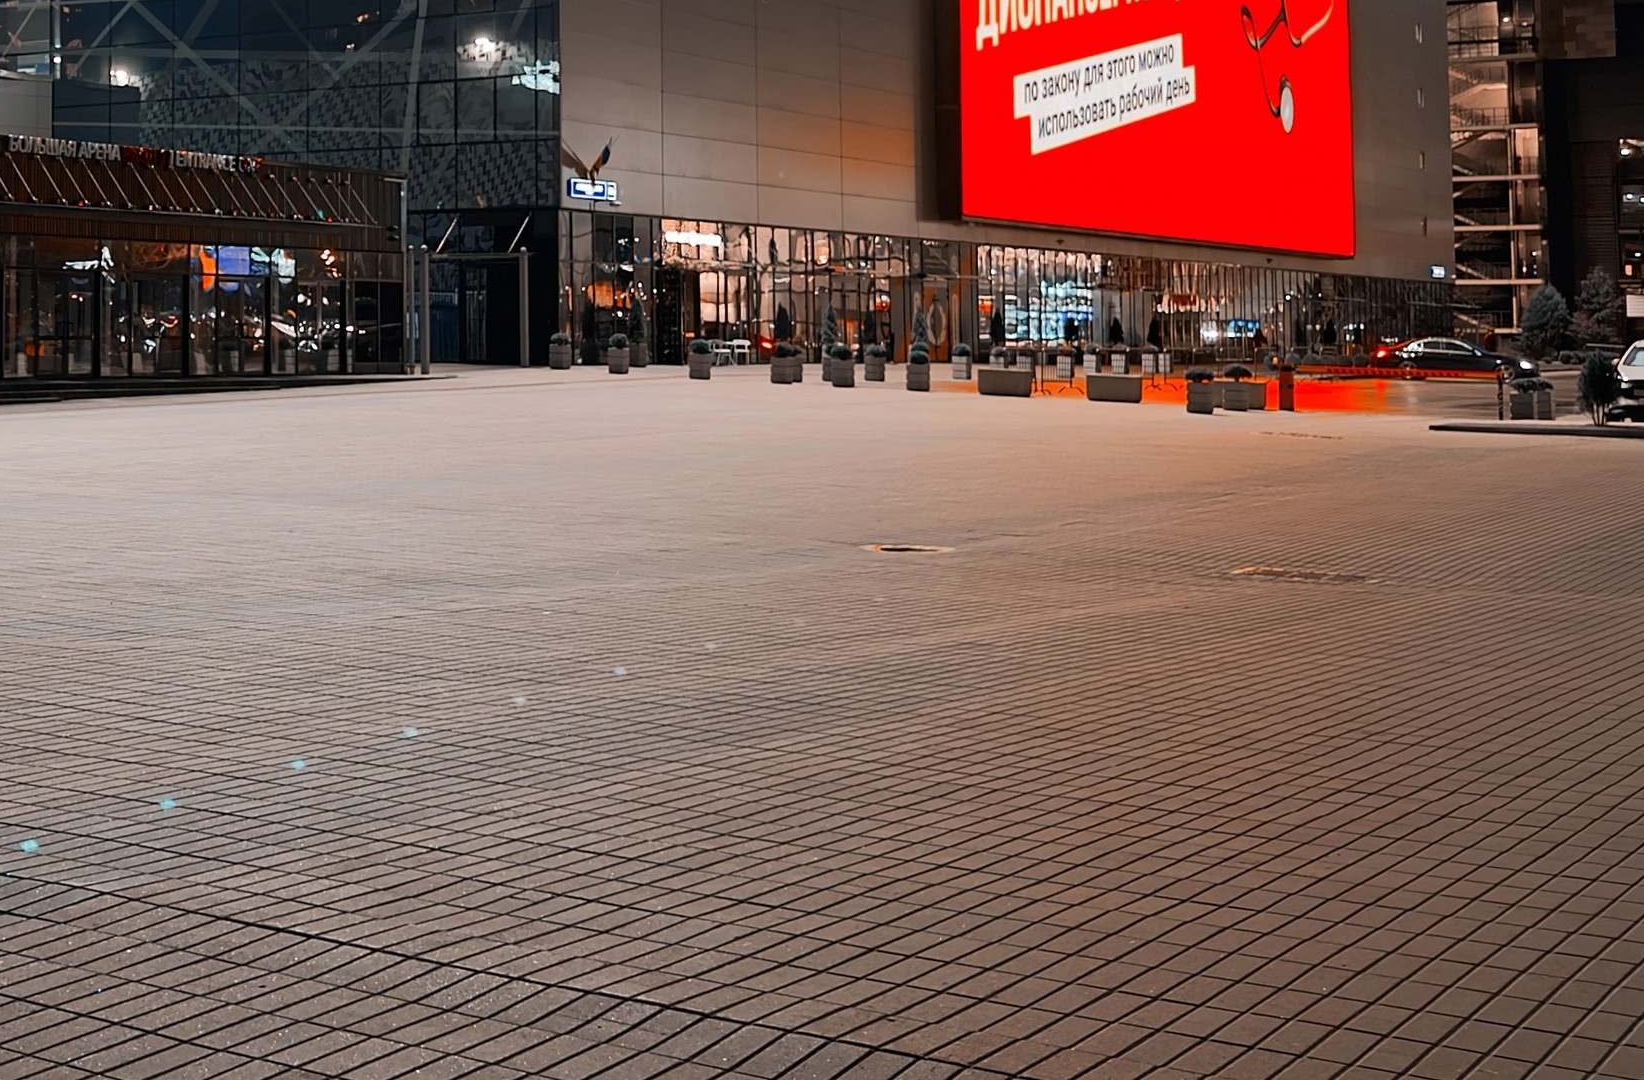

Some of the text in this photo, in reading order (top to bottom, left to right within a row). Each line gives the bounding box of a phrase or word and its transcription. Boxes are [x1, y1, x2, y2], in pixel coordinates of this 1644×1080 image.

[1024, 43, 1174, 104] по закону для этого можно
[1038, 76, 1190, 139] использовать рабочий день
[8, 134, 76, 158] БОЛЬШАЯ
[78, 141, 121, 161] АРЕНА
